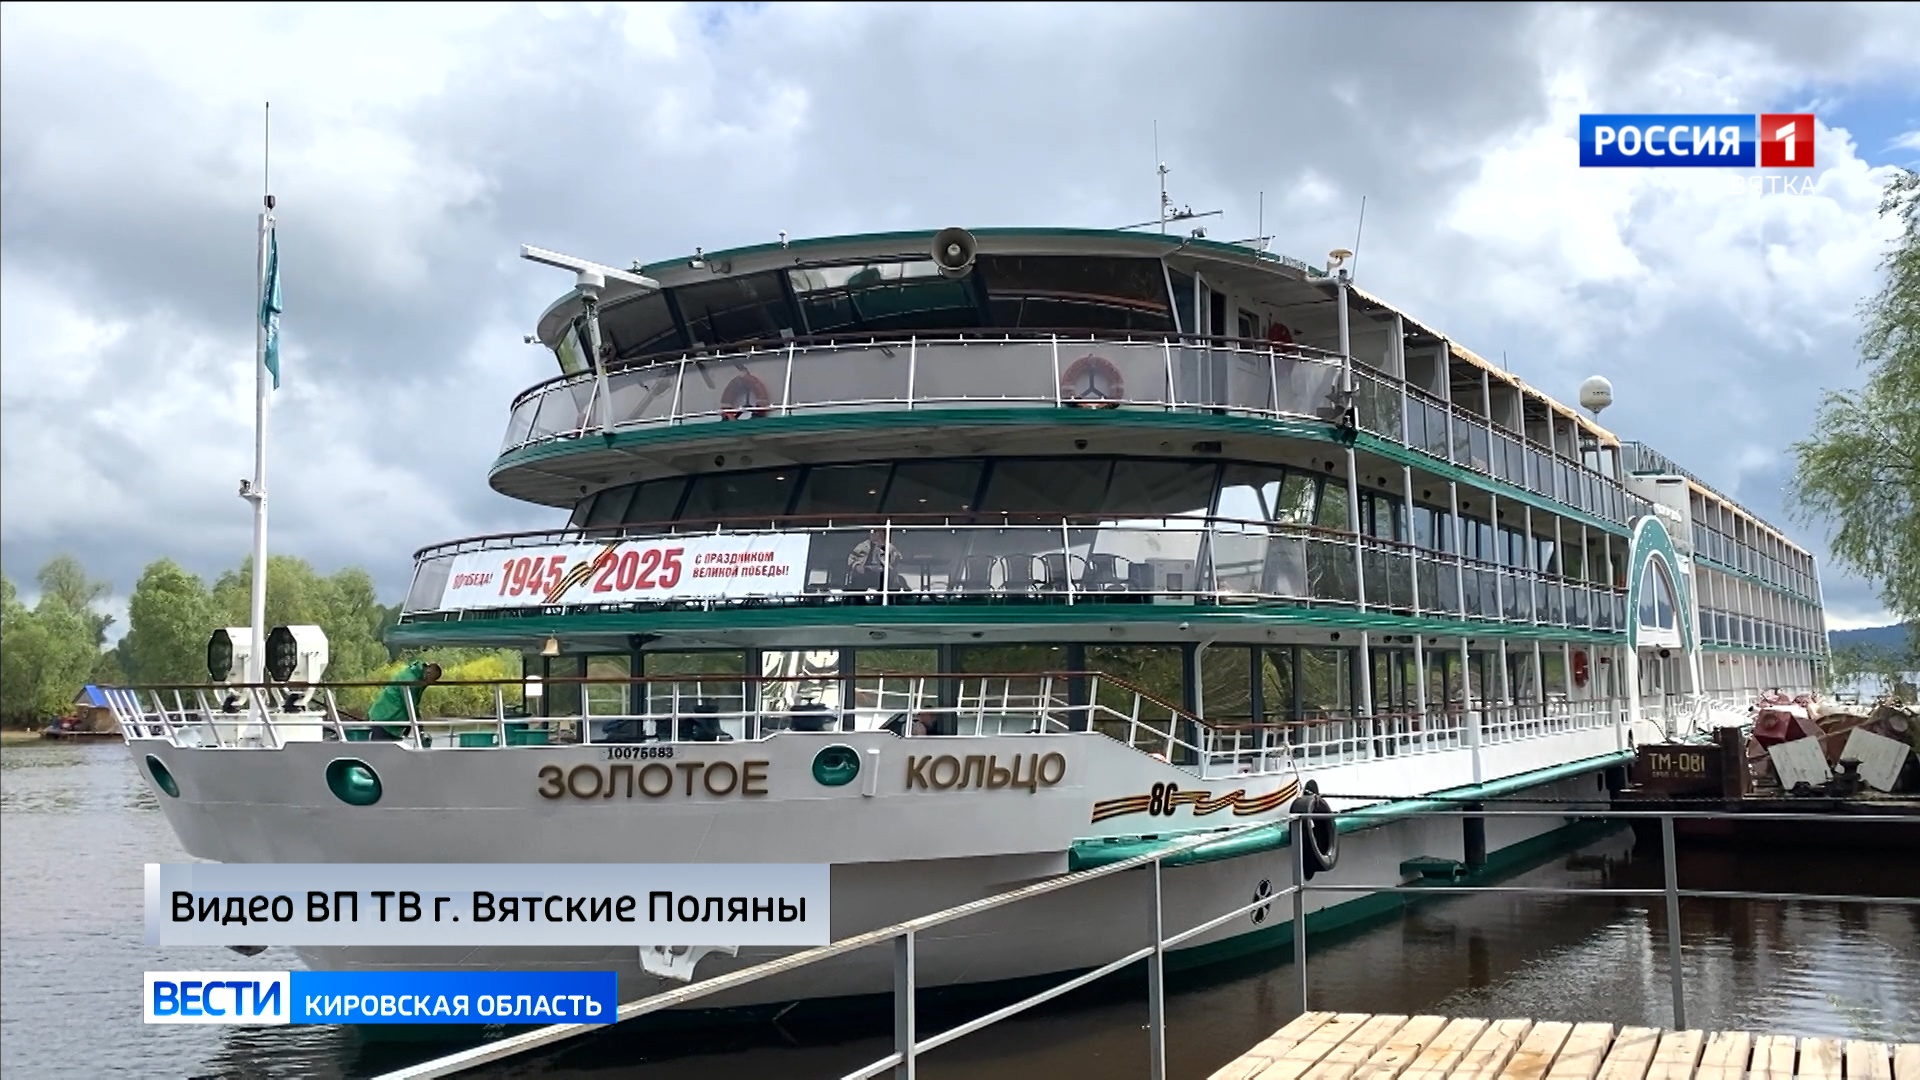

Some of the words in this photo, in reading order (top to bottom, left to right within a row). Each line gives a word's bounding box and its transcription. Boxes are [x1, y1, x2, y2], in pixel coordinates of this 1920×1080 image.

[498, 556, 567, 598] 1945
[592, 547, 685, 593] 2025
[692, 565, 739, 578] ВЕЛИКОЙ
[741, 565, 789, 578] ПОБЕДЫ!
[695, 553, 702, 564] С
[704, 551, 774, 565] ПРАЗДНИКОМ
[537, 760, 770, 801] ЗОЛОТОЕ
[905, 752, 1067, 794] КОЛЬЦО
